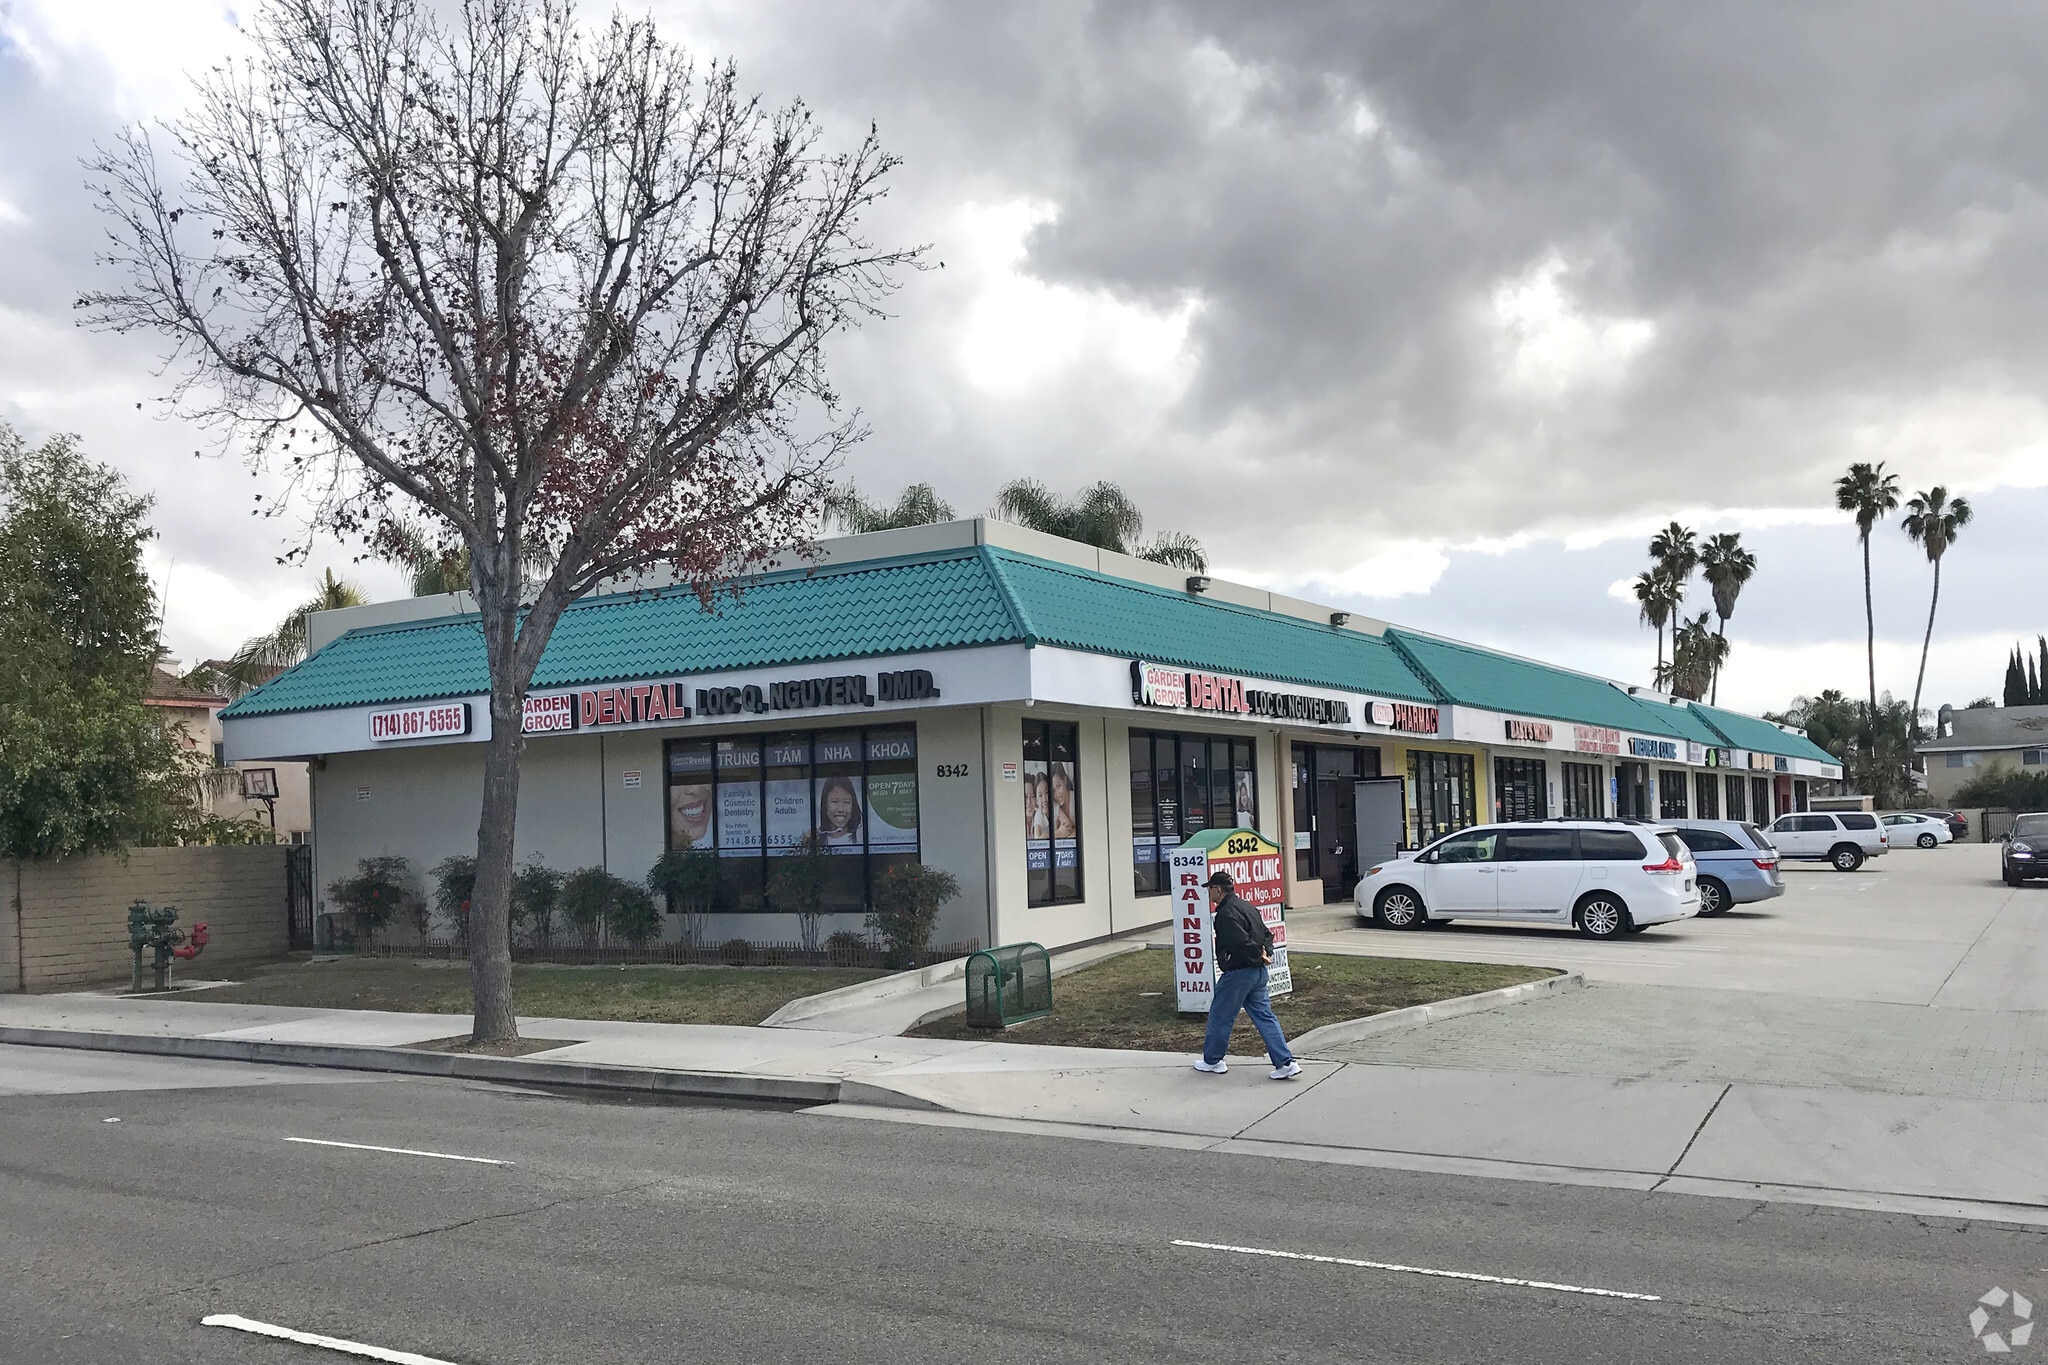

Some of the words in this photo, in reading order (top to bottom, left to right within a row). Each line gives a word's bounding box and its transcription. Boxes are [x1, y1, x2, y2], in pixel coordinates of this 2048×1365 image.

[1147, 669, 1185, 688] GARDEN
[696, 686, 738, 716] LOC
[770, 675, 874, 710] NGUYEN,
[878, 669, 940, 701] DMD.
[1154, 687, 1185, 705] GROVE
[1190, 673, 1249, 713] DENTAL
[522, 695, 570, 714] ARDEN
[580, 683, 684, 726] DENTAL
[1254, 690, 1274, 715] LOC
[372, 713, 401, 737] (714)
[402, 707, 461, 735] 867-6555
[524, 713, 571, 731] GROVE
[1395, 703, 1439, 734] PHARMACY
[717, 752, 760, 766] TRUNG
[774, 747, 801, 763] TÂM
[824, 746, 852, 760] NHA
[871, 743, 910, 758] KHOA
[936, 763, 969, 777] 8342
[868, 782, 891, 790] OPEN
[891, 781, 899, 795] 7
[898, 780, 916, 789] DAYS
[723, 799, 756, 807] Cosmetic
[774, 796, 804, 805] Children
[724, 808, 755, 817] Dentistry
[774, 806, 797, 815] Adults
[767, 834, 793, 844] 6555
[1228, 837, 1258, 855] 8342
[1028, 851, 1047, 860] OPEN
[1055, 851, 1061, 867] 7
[1060, 850, 1074, 859] DAYS
[1173, 856, 1204, 867] 8342
[1252, 857, 1281, 883] CLINIC
[1241, 888, 1253, 902] Loi
[1254, 886, 1271, 903] Ngo,
[1271, 887, 1282, 898] DO
[1180, 873, 1204, 974] RAINBOW
[1180, 981, 1211, 993] PLAZA
